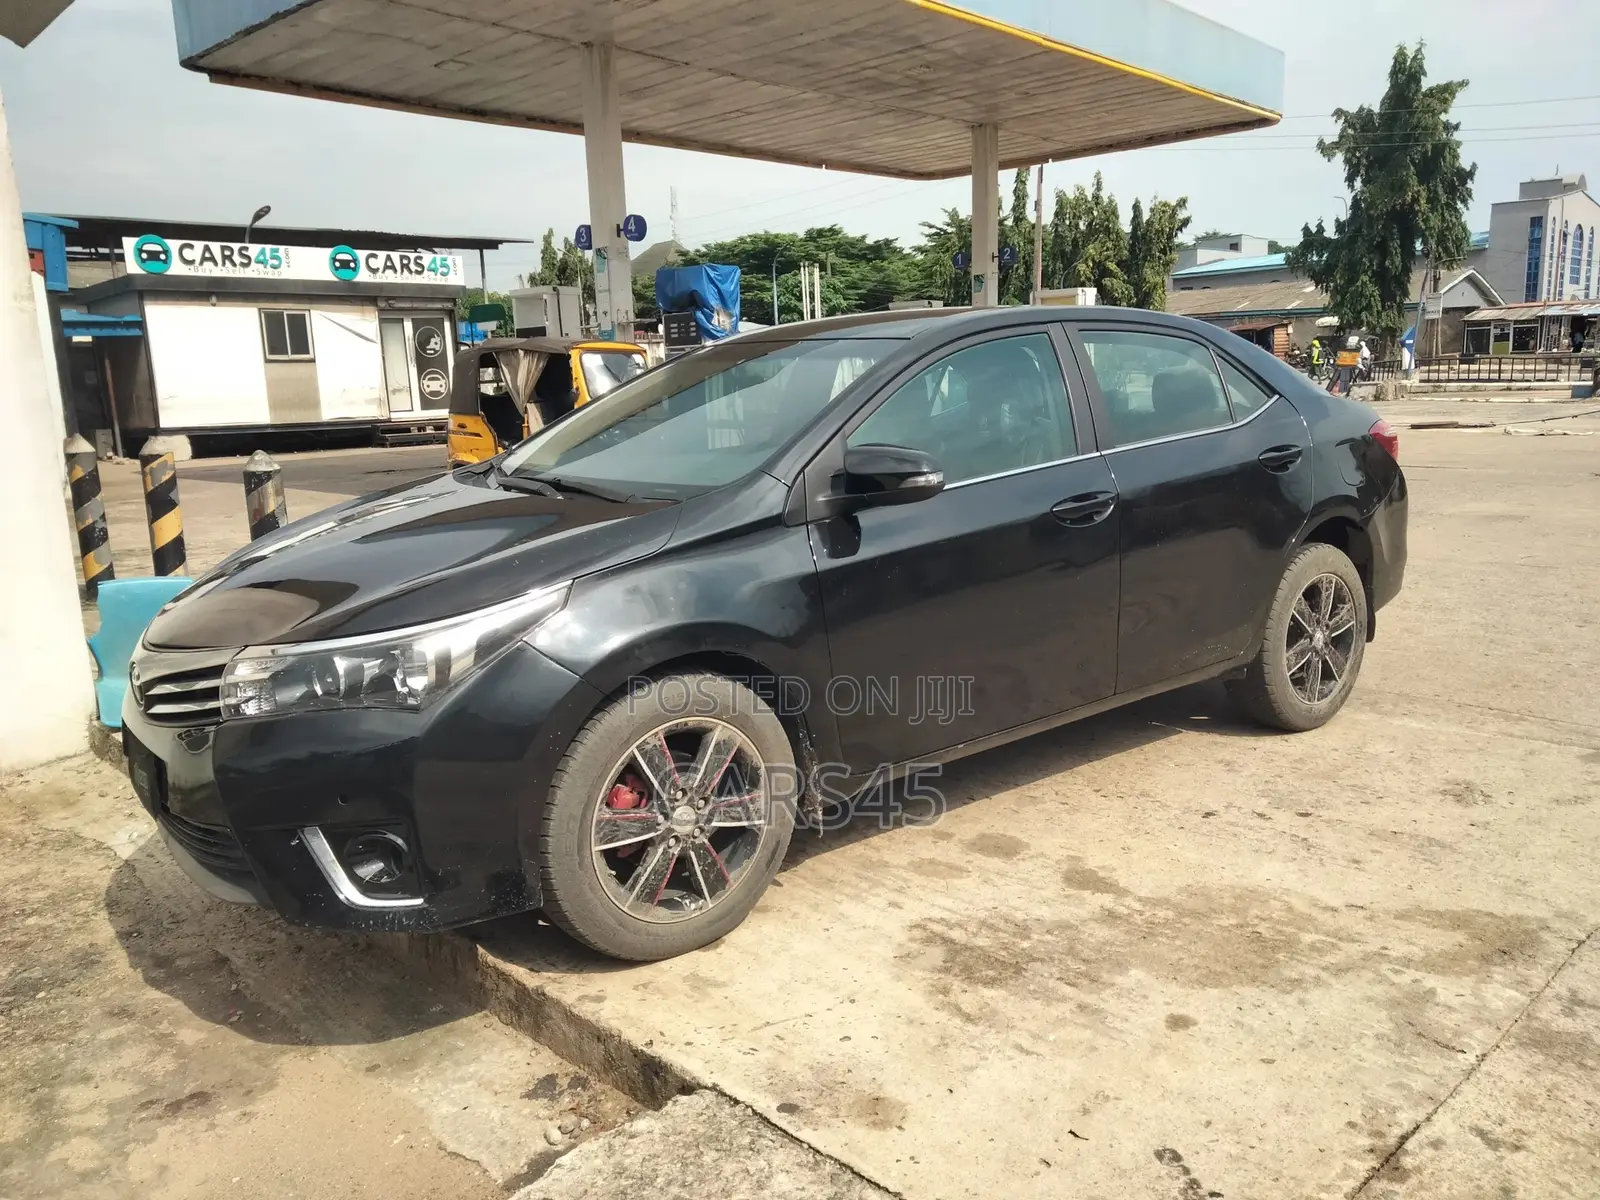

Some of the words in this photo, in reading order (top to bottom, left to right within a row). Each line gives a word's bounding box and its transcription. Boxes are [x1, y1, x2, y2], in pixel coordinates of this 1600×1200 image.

[628, 216, 636, 233] 4
[580, 228, 587, 242] 3
[178, 242, 283, 270] CARS45
[956, 253, 962, 265] 1
[1003, 247, 1011, 259] 2
[365, 252, 451, 277] CARS45
